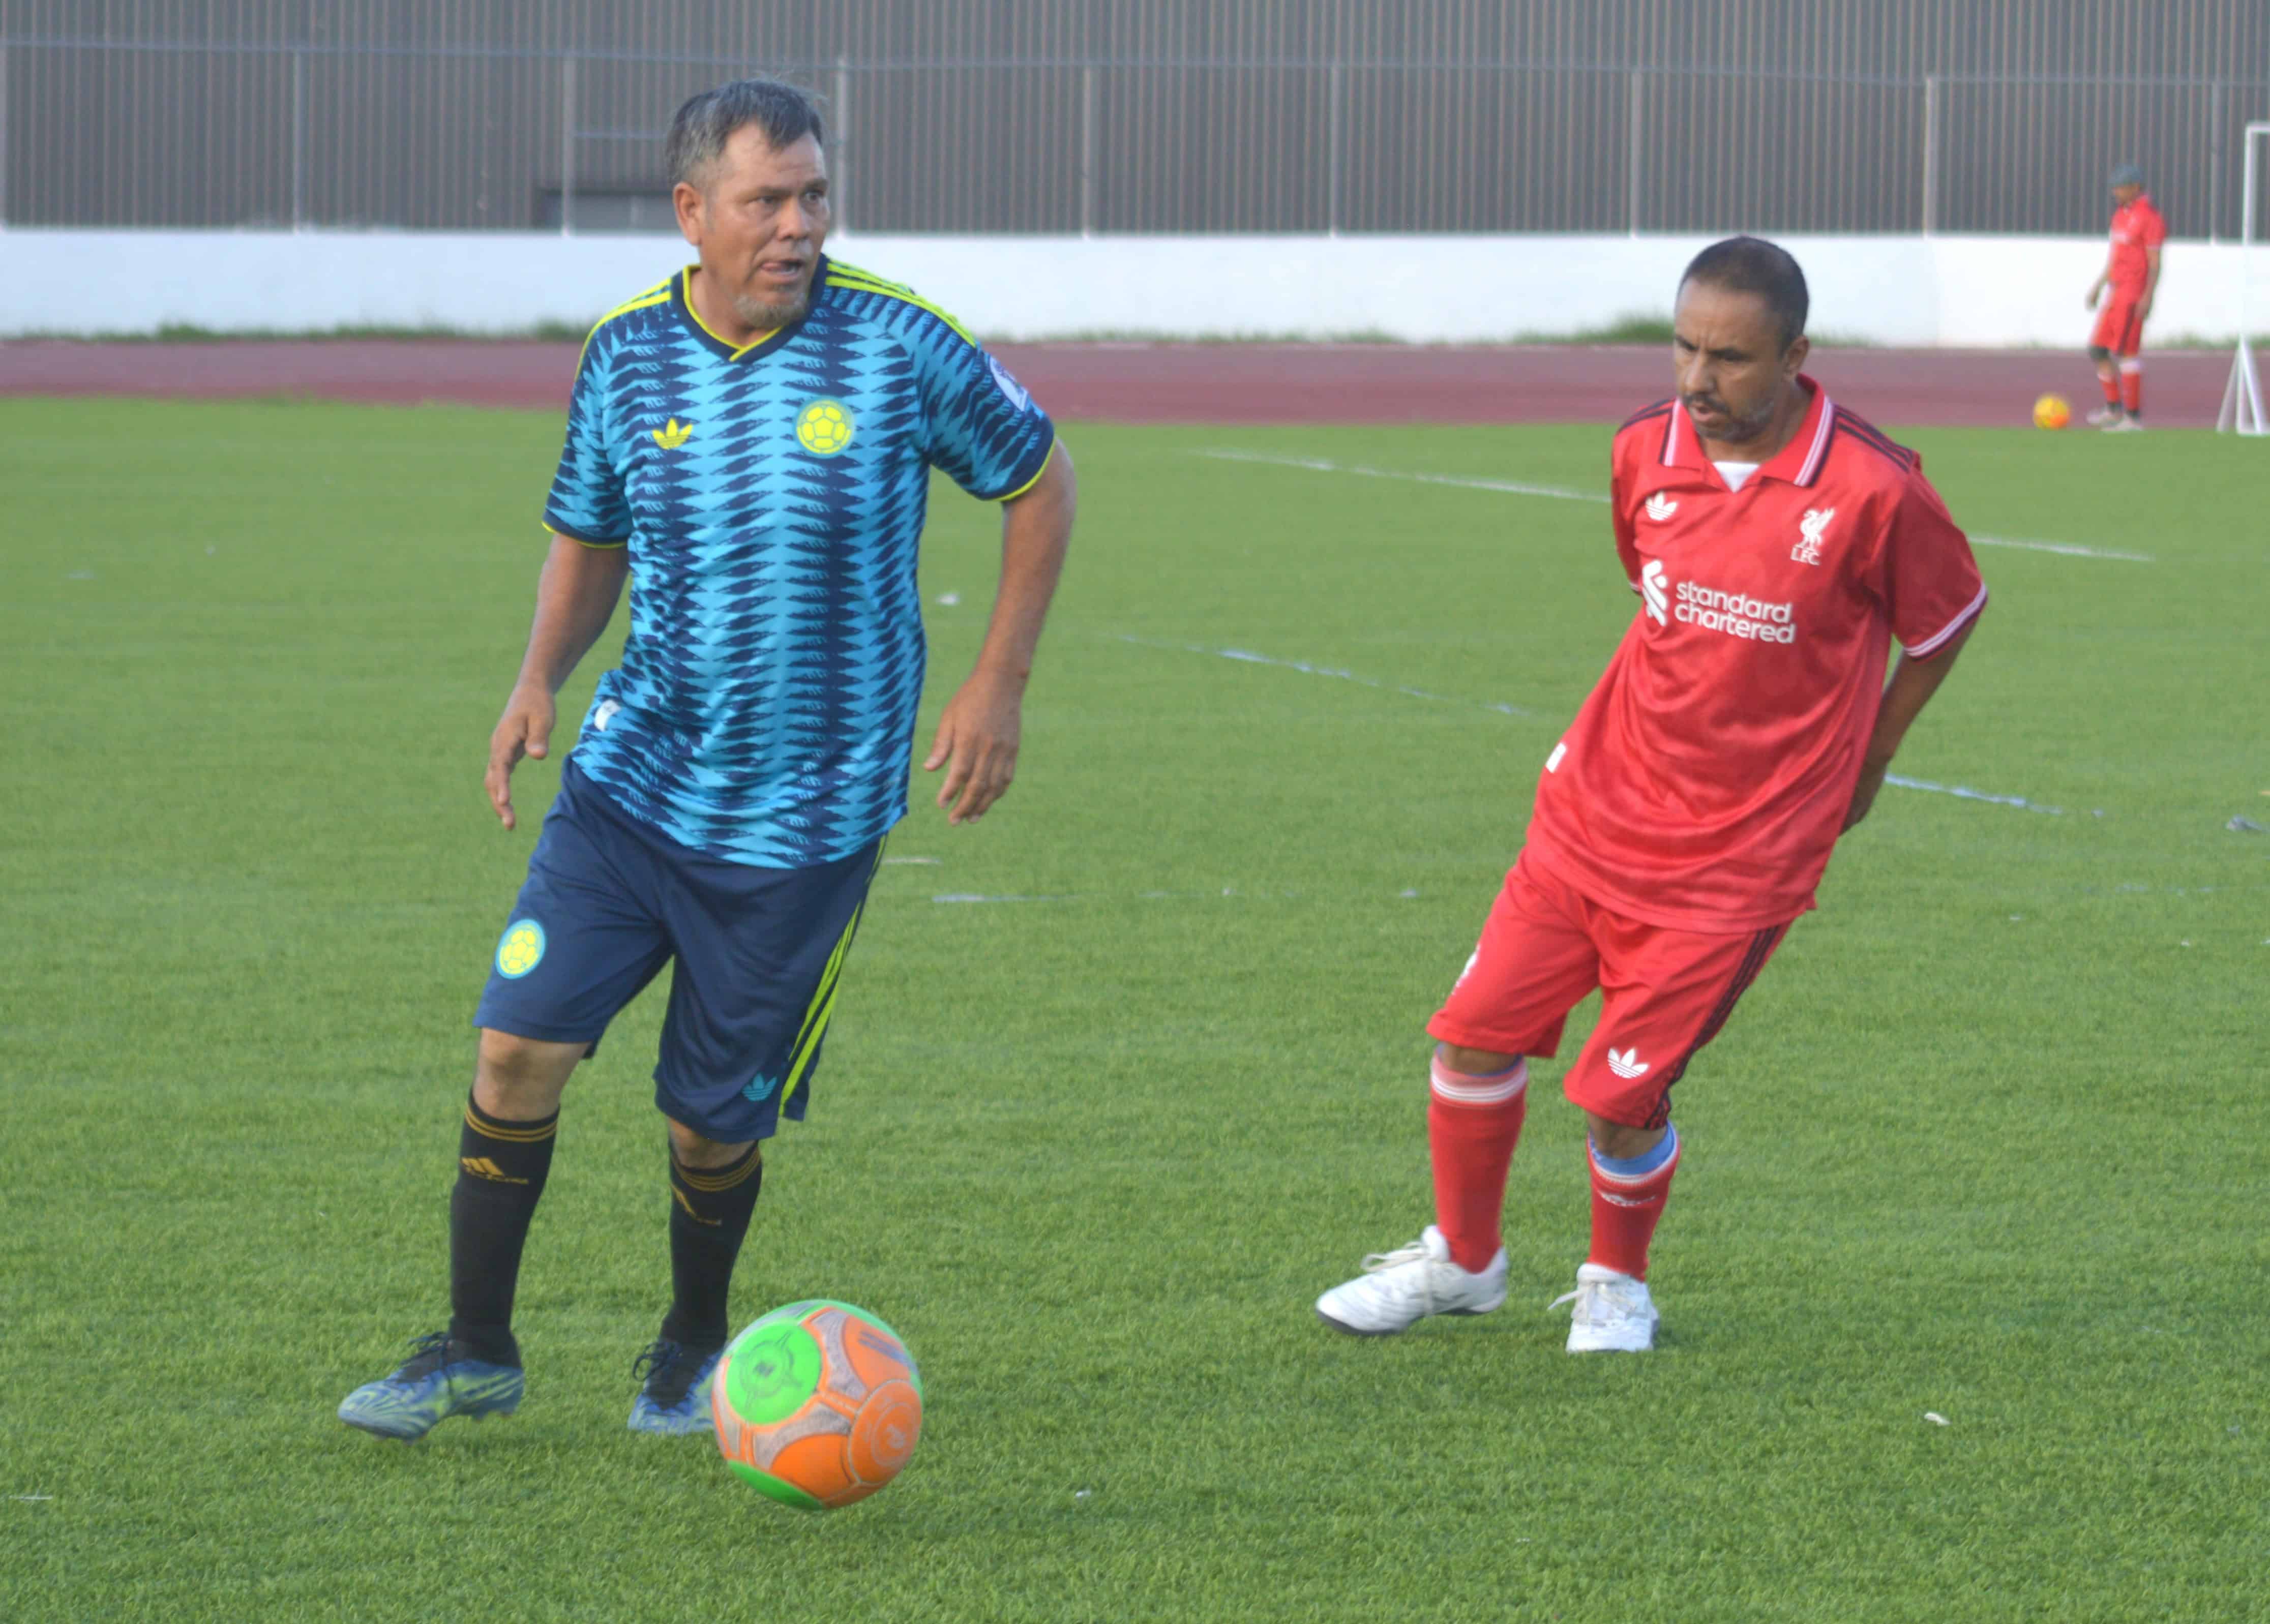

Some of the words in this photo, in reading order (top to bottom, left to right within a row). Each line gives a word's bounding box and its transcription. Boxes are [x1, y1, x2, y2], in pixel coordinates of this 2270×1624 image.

[1790, 547, 1820, 565] LFC
[1676, 581, 1793, 623] standard
[1674, 603, 1796, 643] chartered
